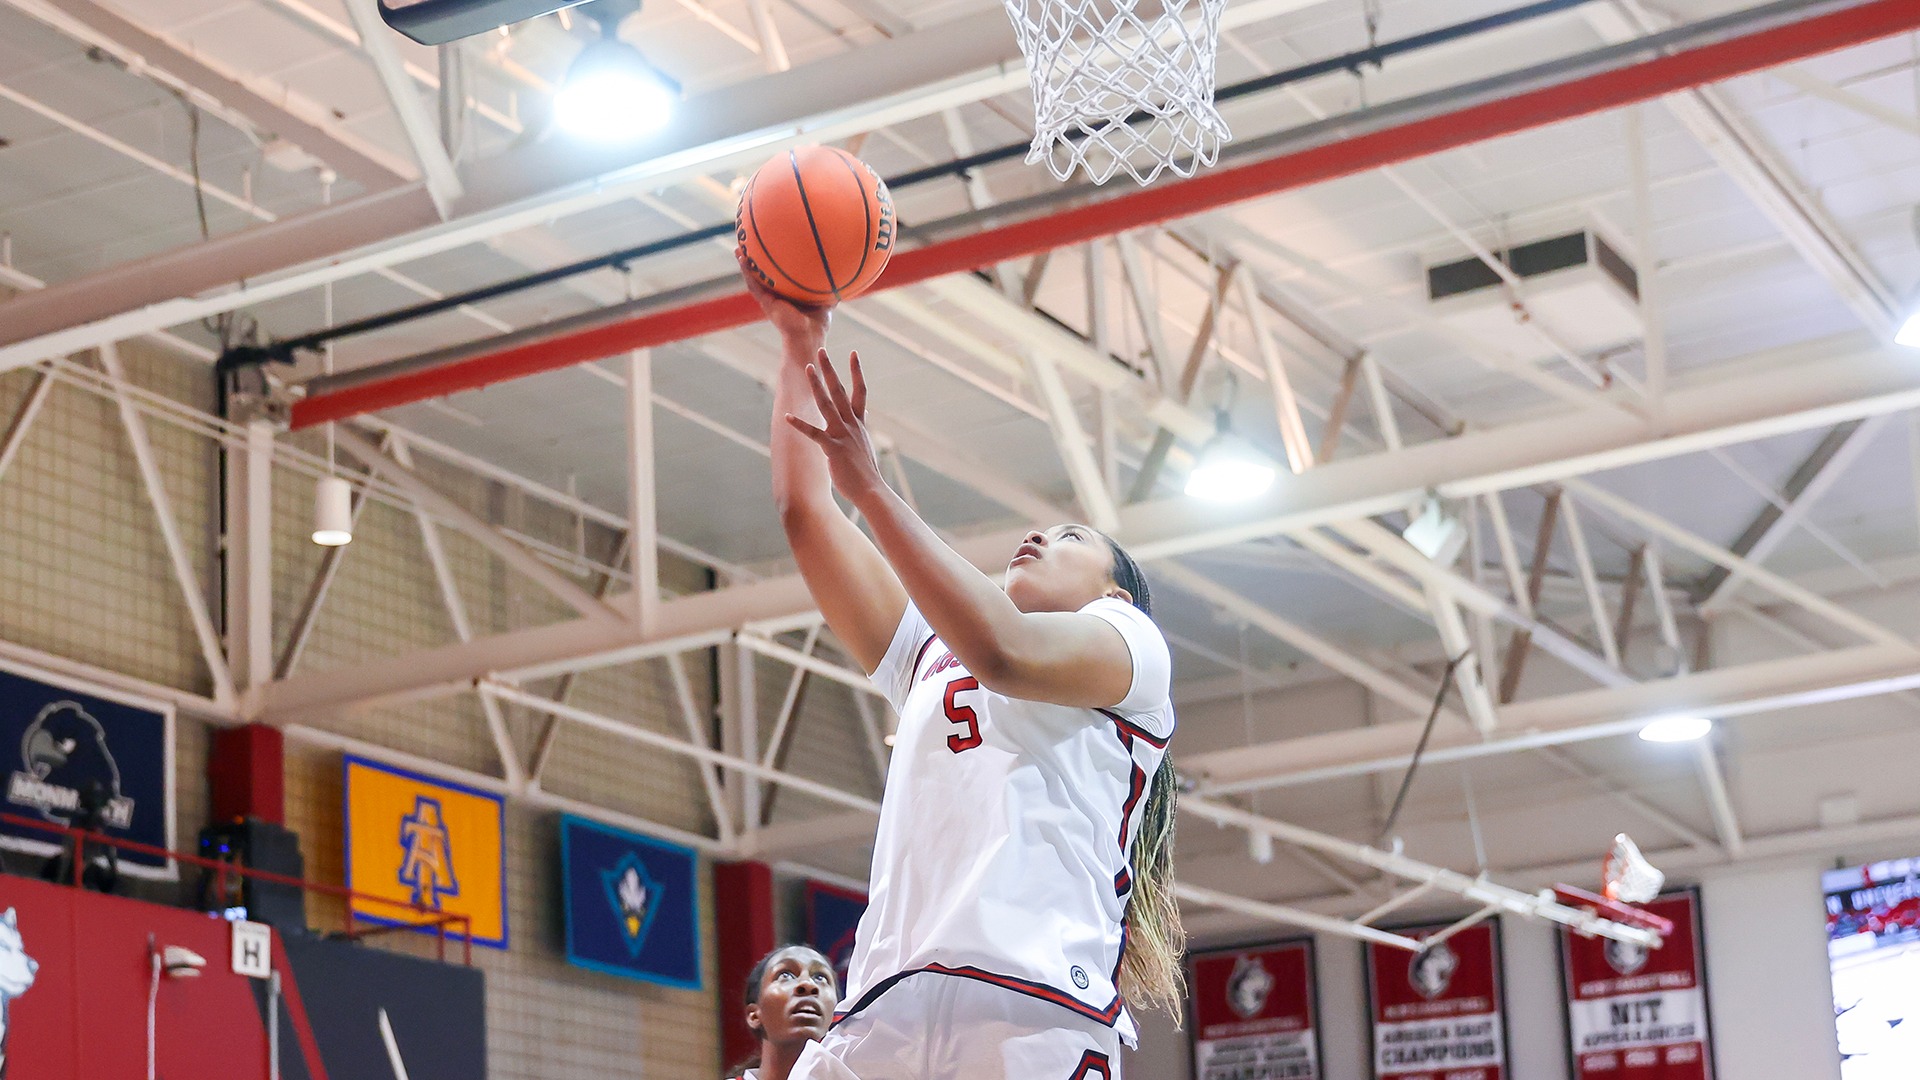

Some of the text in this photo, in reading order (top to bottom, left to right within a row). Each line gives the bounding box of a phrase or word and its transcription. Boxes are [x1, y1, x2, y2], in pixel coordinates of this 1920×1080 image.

[943, 675, 983, 754] 5
[243, 938, 260, 968] H
[1610, 998, 1662, 1026] NIT
[1381, 1038, 1495, 1066] CHAMPIONS
